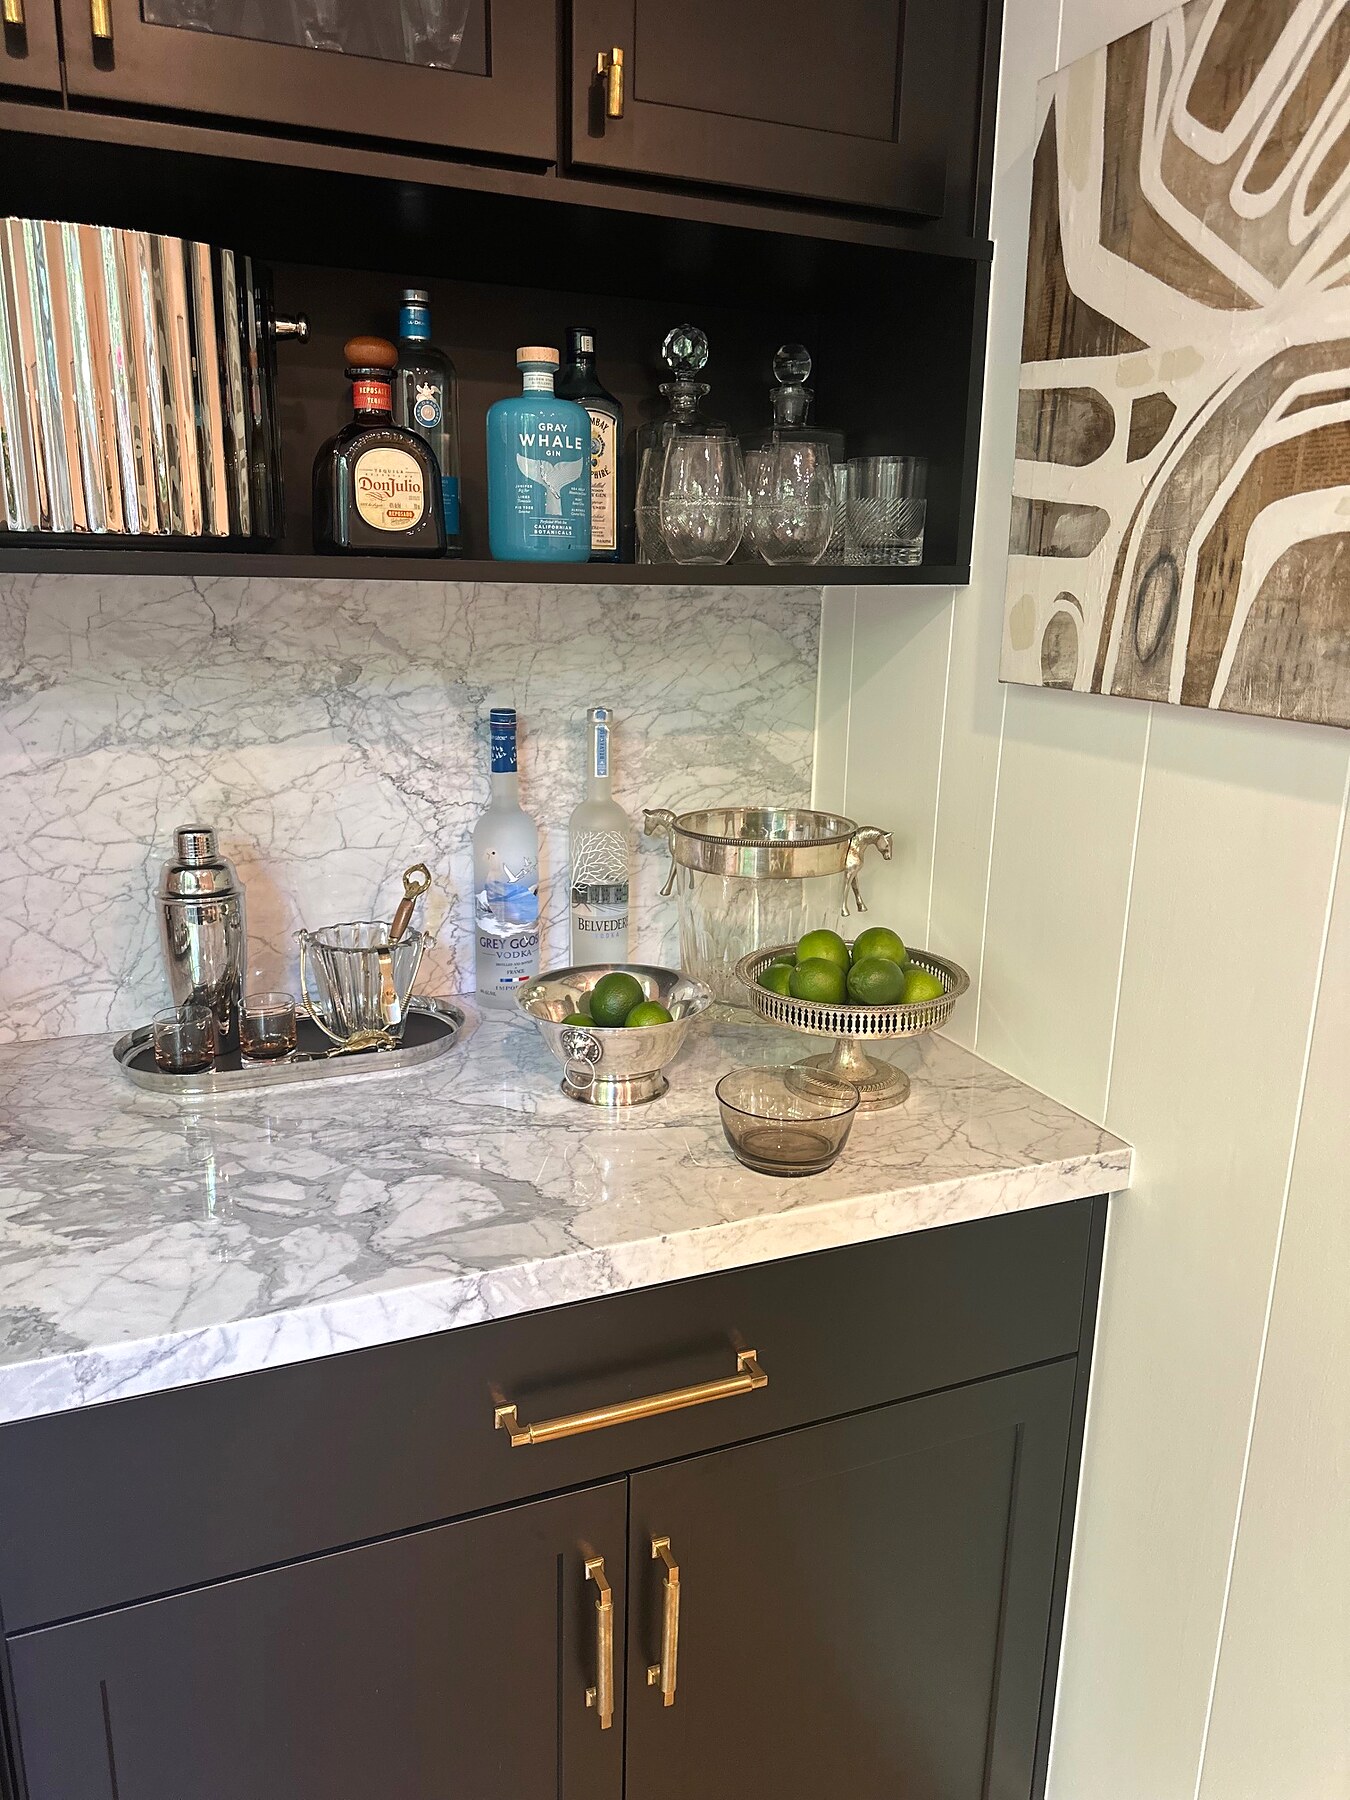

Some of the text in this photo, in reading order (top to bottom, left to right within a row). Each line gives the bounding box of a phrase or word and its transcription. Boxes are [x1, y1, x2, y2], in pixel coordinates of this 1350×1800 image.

[538, 423, 568, 433] GRAY
[590, 417, 609, 433] MBAY
[519, 433, 583, 450] WHALE
[591, 467, 611, 479] PHIRE
[578, 916, 628, 932] BELVEDER
[479, 934, 539, 950] GREY GOOS
[496, 949, 533, 959] VODKA
